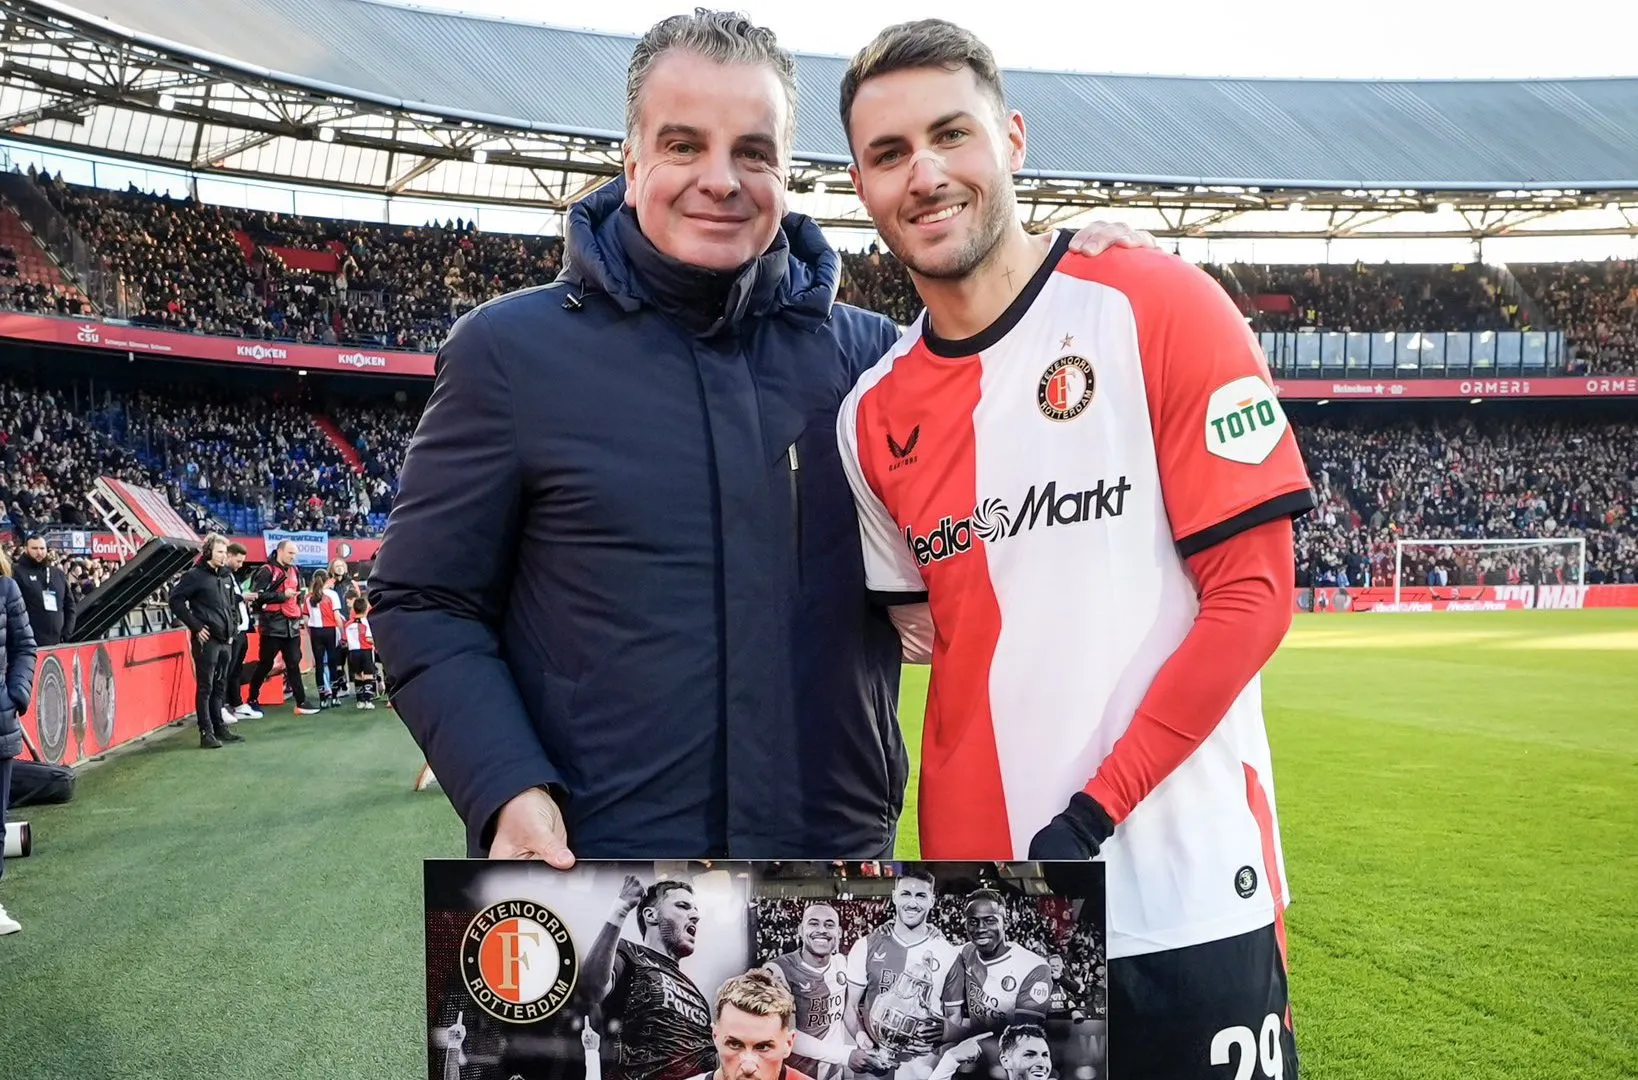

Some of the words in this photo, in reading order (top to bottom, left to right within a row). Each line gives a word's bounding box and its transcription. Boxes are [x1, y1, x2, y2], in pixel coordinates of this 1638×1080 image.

[77, 332, 99, 343] CSU
[237, 345, 287, 359] KNAKEN
[338, 353, 386, 367] KNAKEN
[1041, 357, 1091, 385] FEYENOORD
[1460, 381, 1520, 394] ORMER
[1586, 380, 1637, 392] ORME
[1040, 389, 1093, 419] ROTTERDAM
[1211, 400, 1275, 444] TOTO
[1008, 476, 1132, 538] Markt
[469, 902, 568, 944] FEYENOORD
[496, 931, 540, 990] F
[470, 977, 569, 1019] ROTTERDAM
[1210, 1012, 1284, 1080] 29
